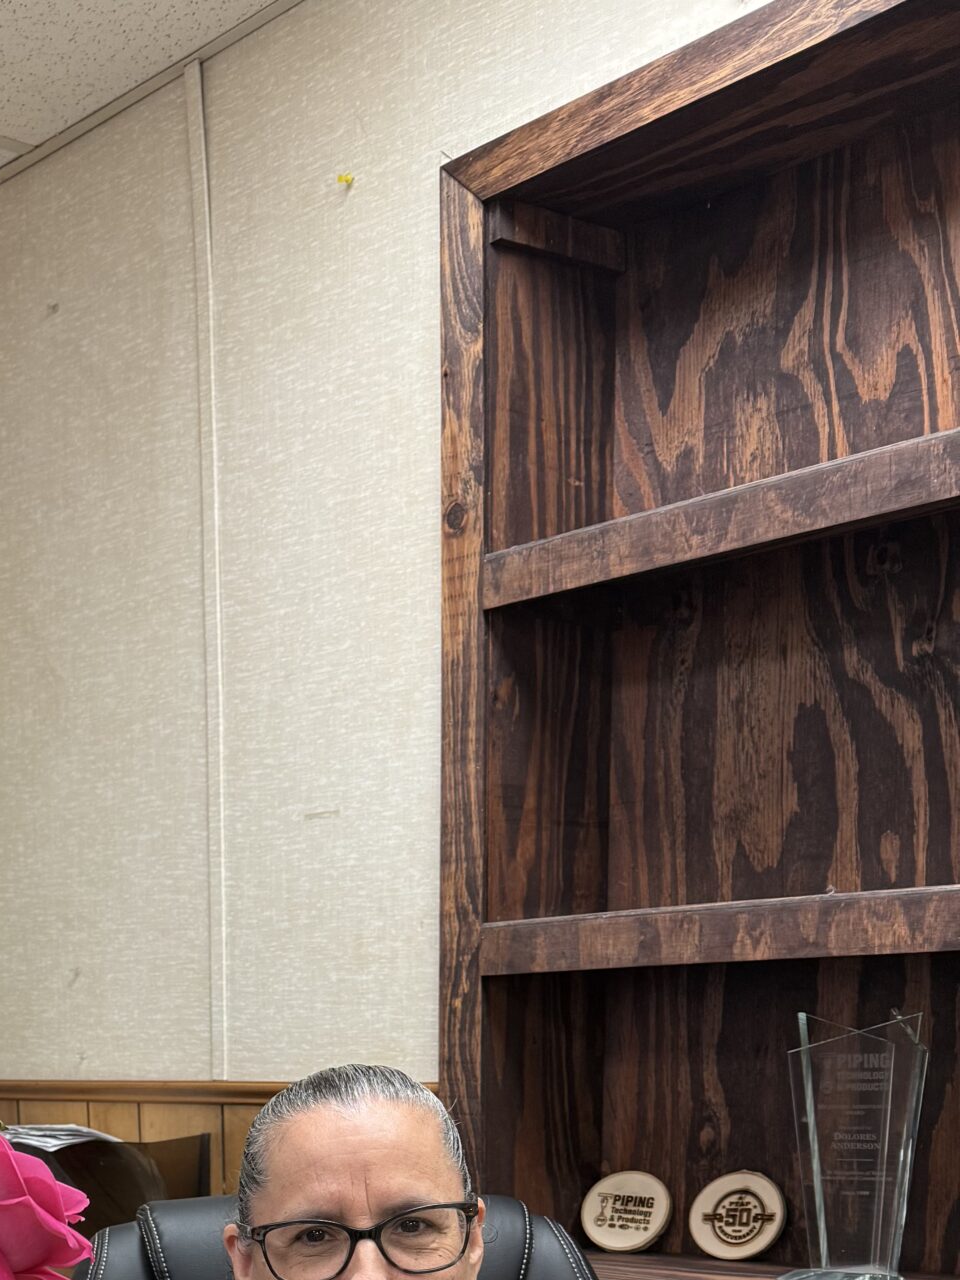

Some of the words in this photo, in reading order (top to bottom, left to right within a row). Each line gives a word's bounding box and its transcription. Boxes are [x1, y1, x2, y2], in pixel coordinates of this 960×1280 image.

[837, 1052, 890, 1069] PIPING
[832, 1132, 878, 1141] DOLORES
[830, 1141, 881, 1150] ANDERSON
[612, 1194, 655, 1209] PIPING
[611, 1206, 653, 1218] Technology
[724, 1207, 752, 1227] 50
[617, 1215, 651, 1225] Products
